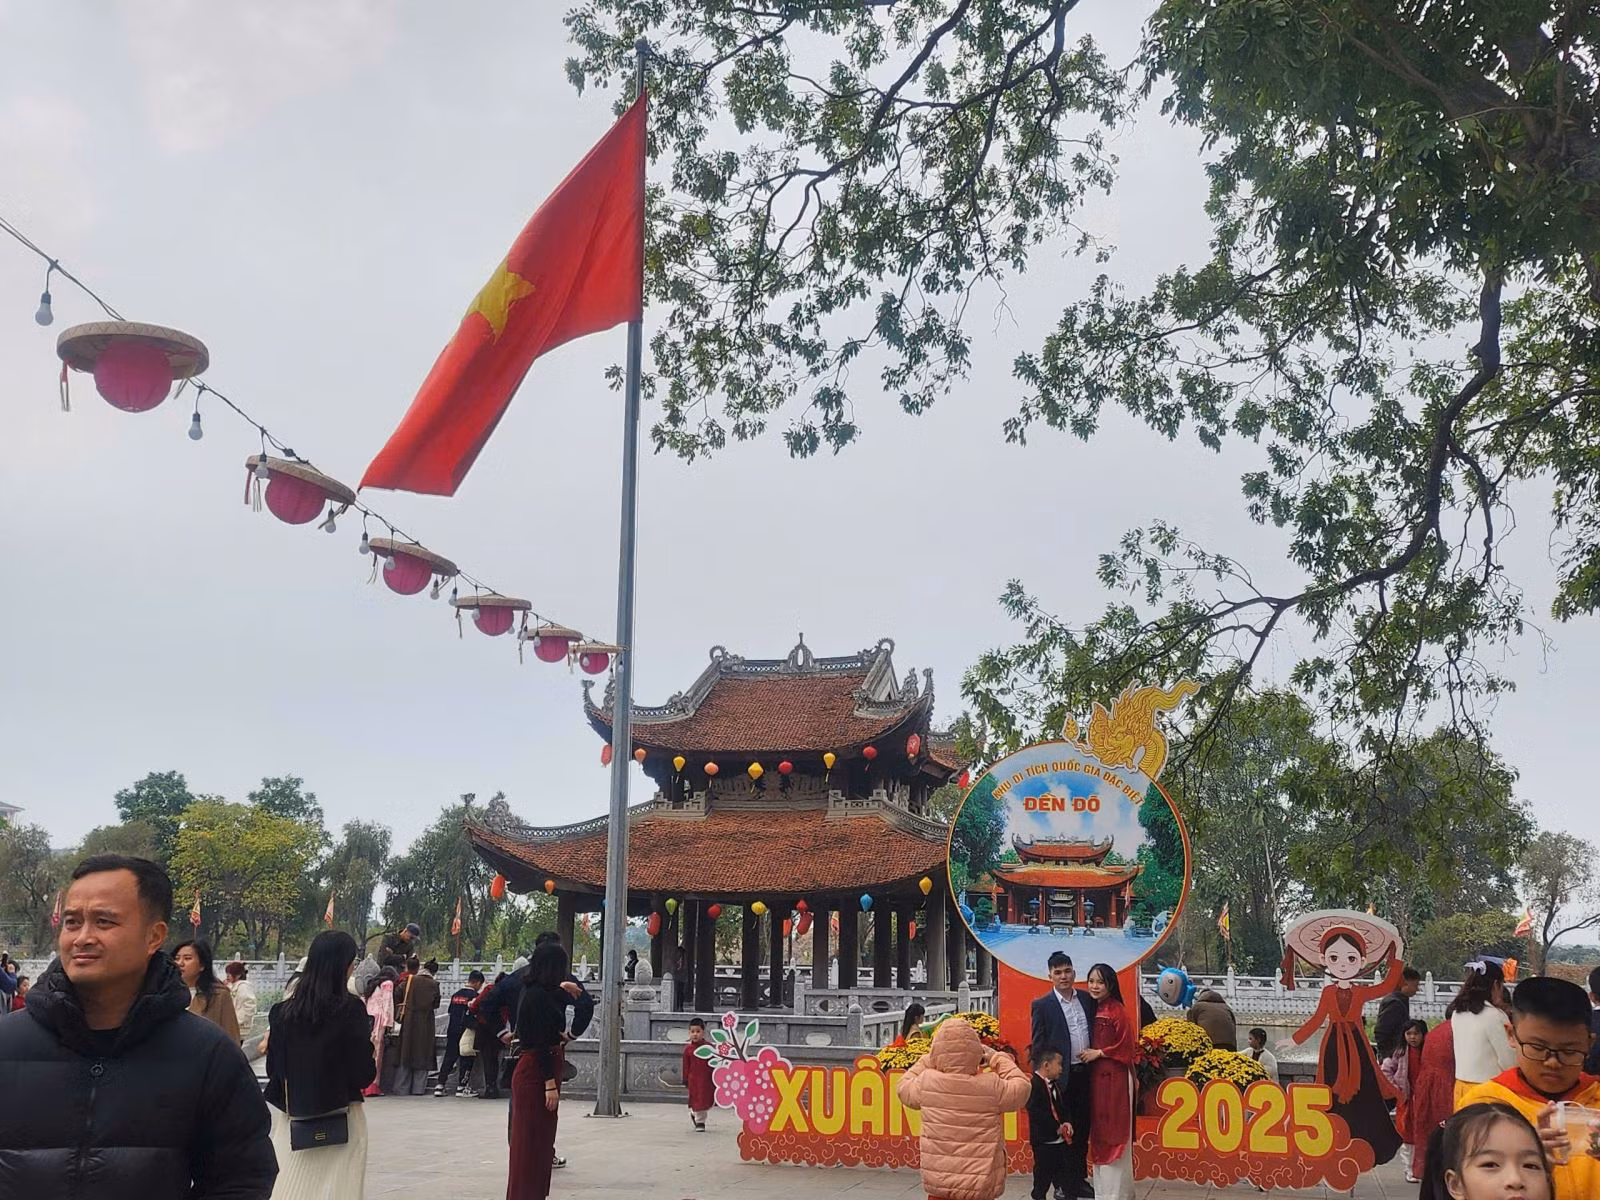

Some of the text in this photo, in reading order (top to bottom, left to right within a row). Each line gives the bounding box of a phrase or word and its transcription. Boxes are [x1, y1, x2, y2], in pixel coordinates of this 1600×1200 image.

[992, 780, 1012, 800] KHU
[1026, 763, 1049, 777] TÍCH
[1052, 758, 1081, 772] QUỐC
[1084, 764, 1101, 777] GIA
[1122, 784, 1144, 805] BIỆT
[1022, 792, 1101, 812] ĐỀN ĐÔ
[1161, 1081, 1334, 1157] 2025
